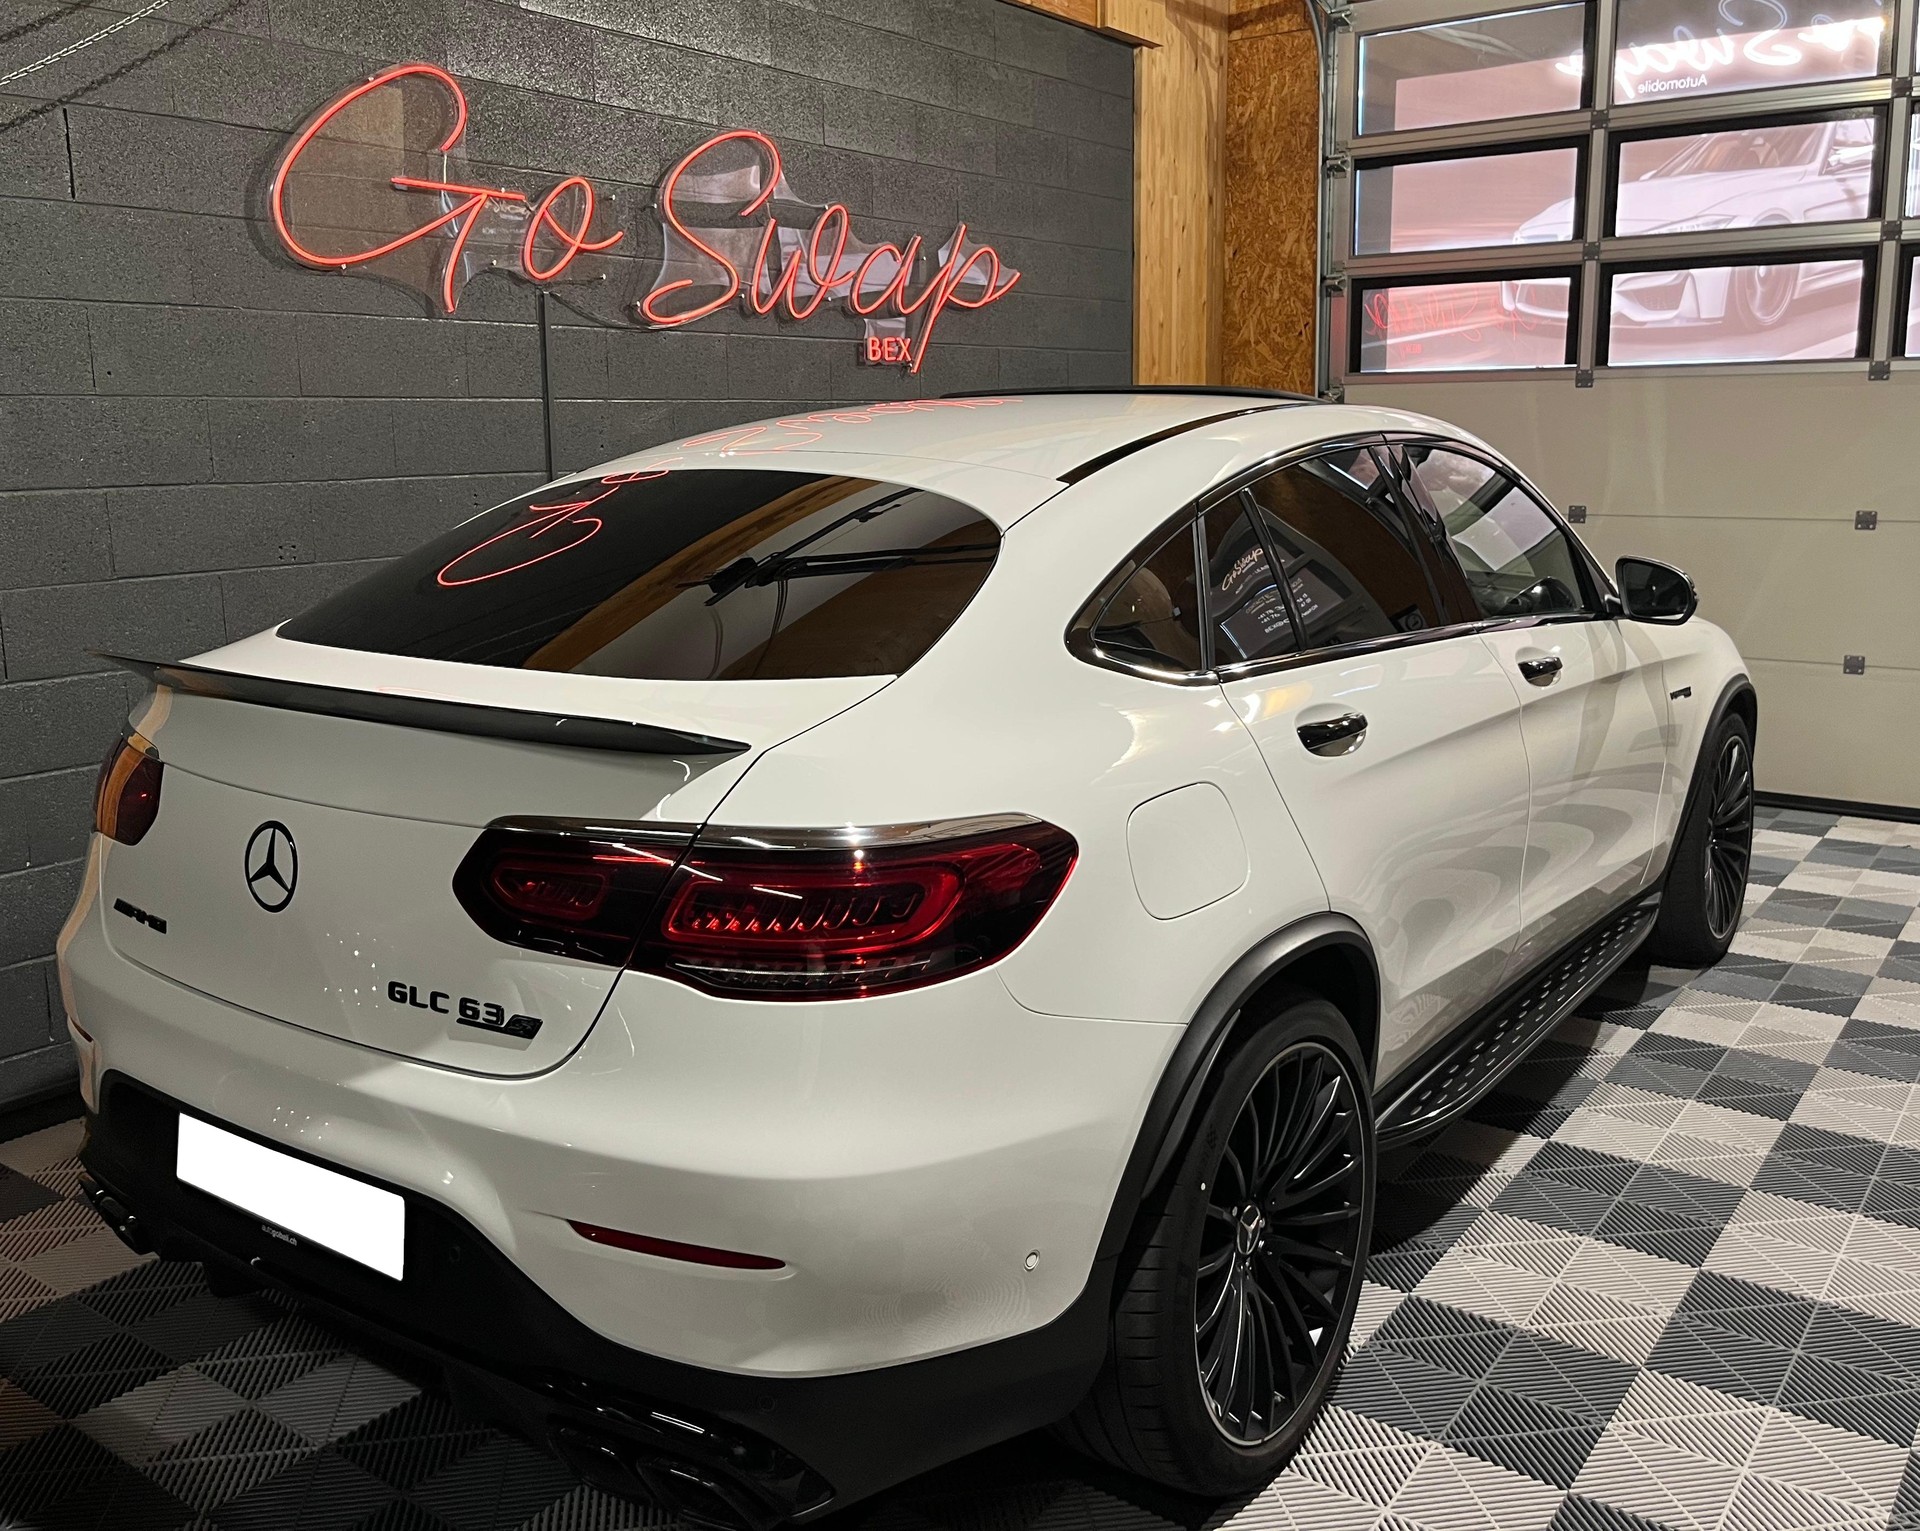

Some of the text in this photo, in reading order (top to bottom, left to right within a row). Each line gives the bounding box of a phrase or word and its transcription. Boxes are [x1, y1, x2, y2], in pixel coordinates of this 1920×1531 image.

[271, 61, 1022, 374] Go Swap
[867, 335, 912, 361] BEX
[387, 980, 450, 1014] GLC
[458, 996, 505, 1026] 63
